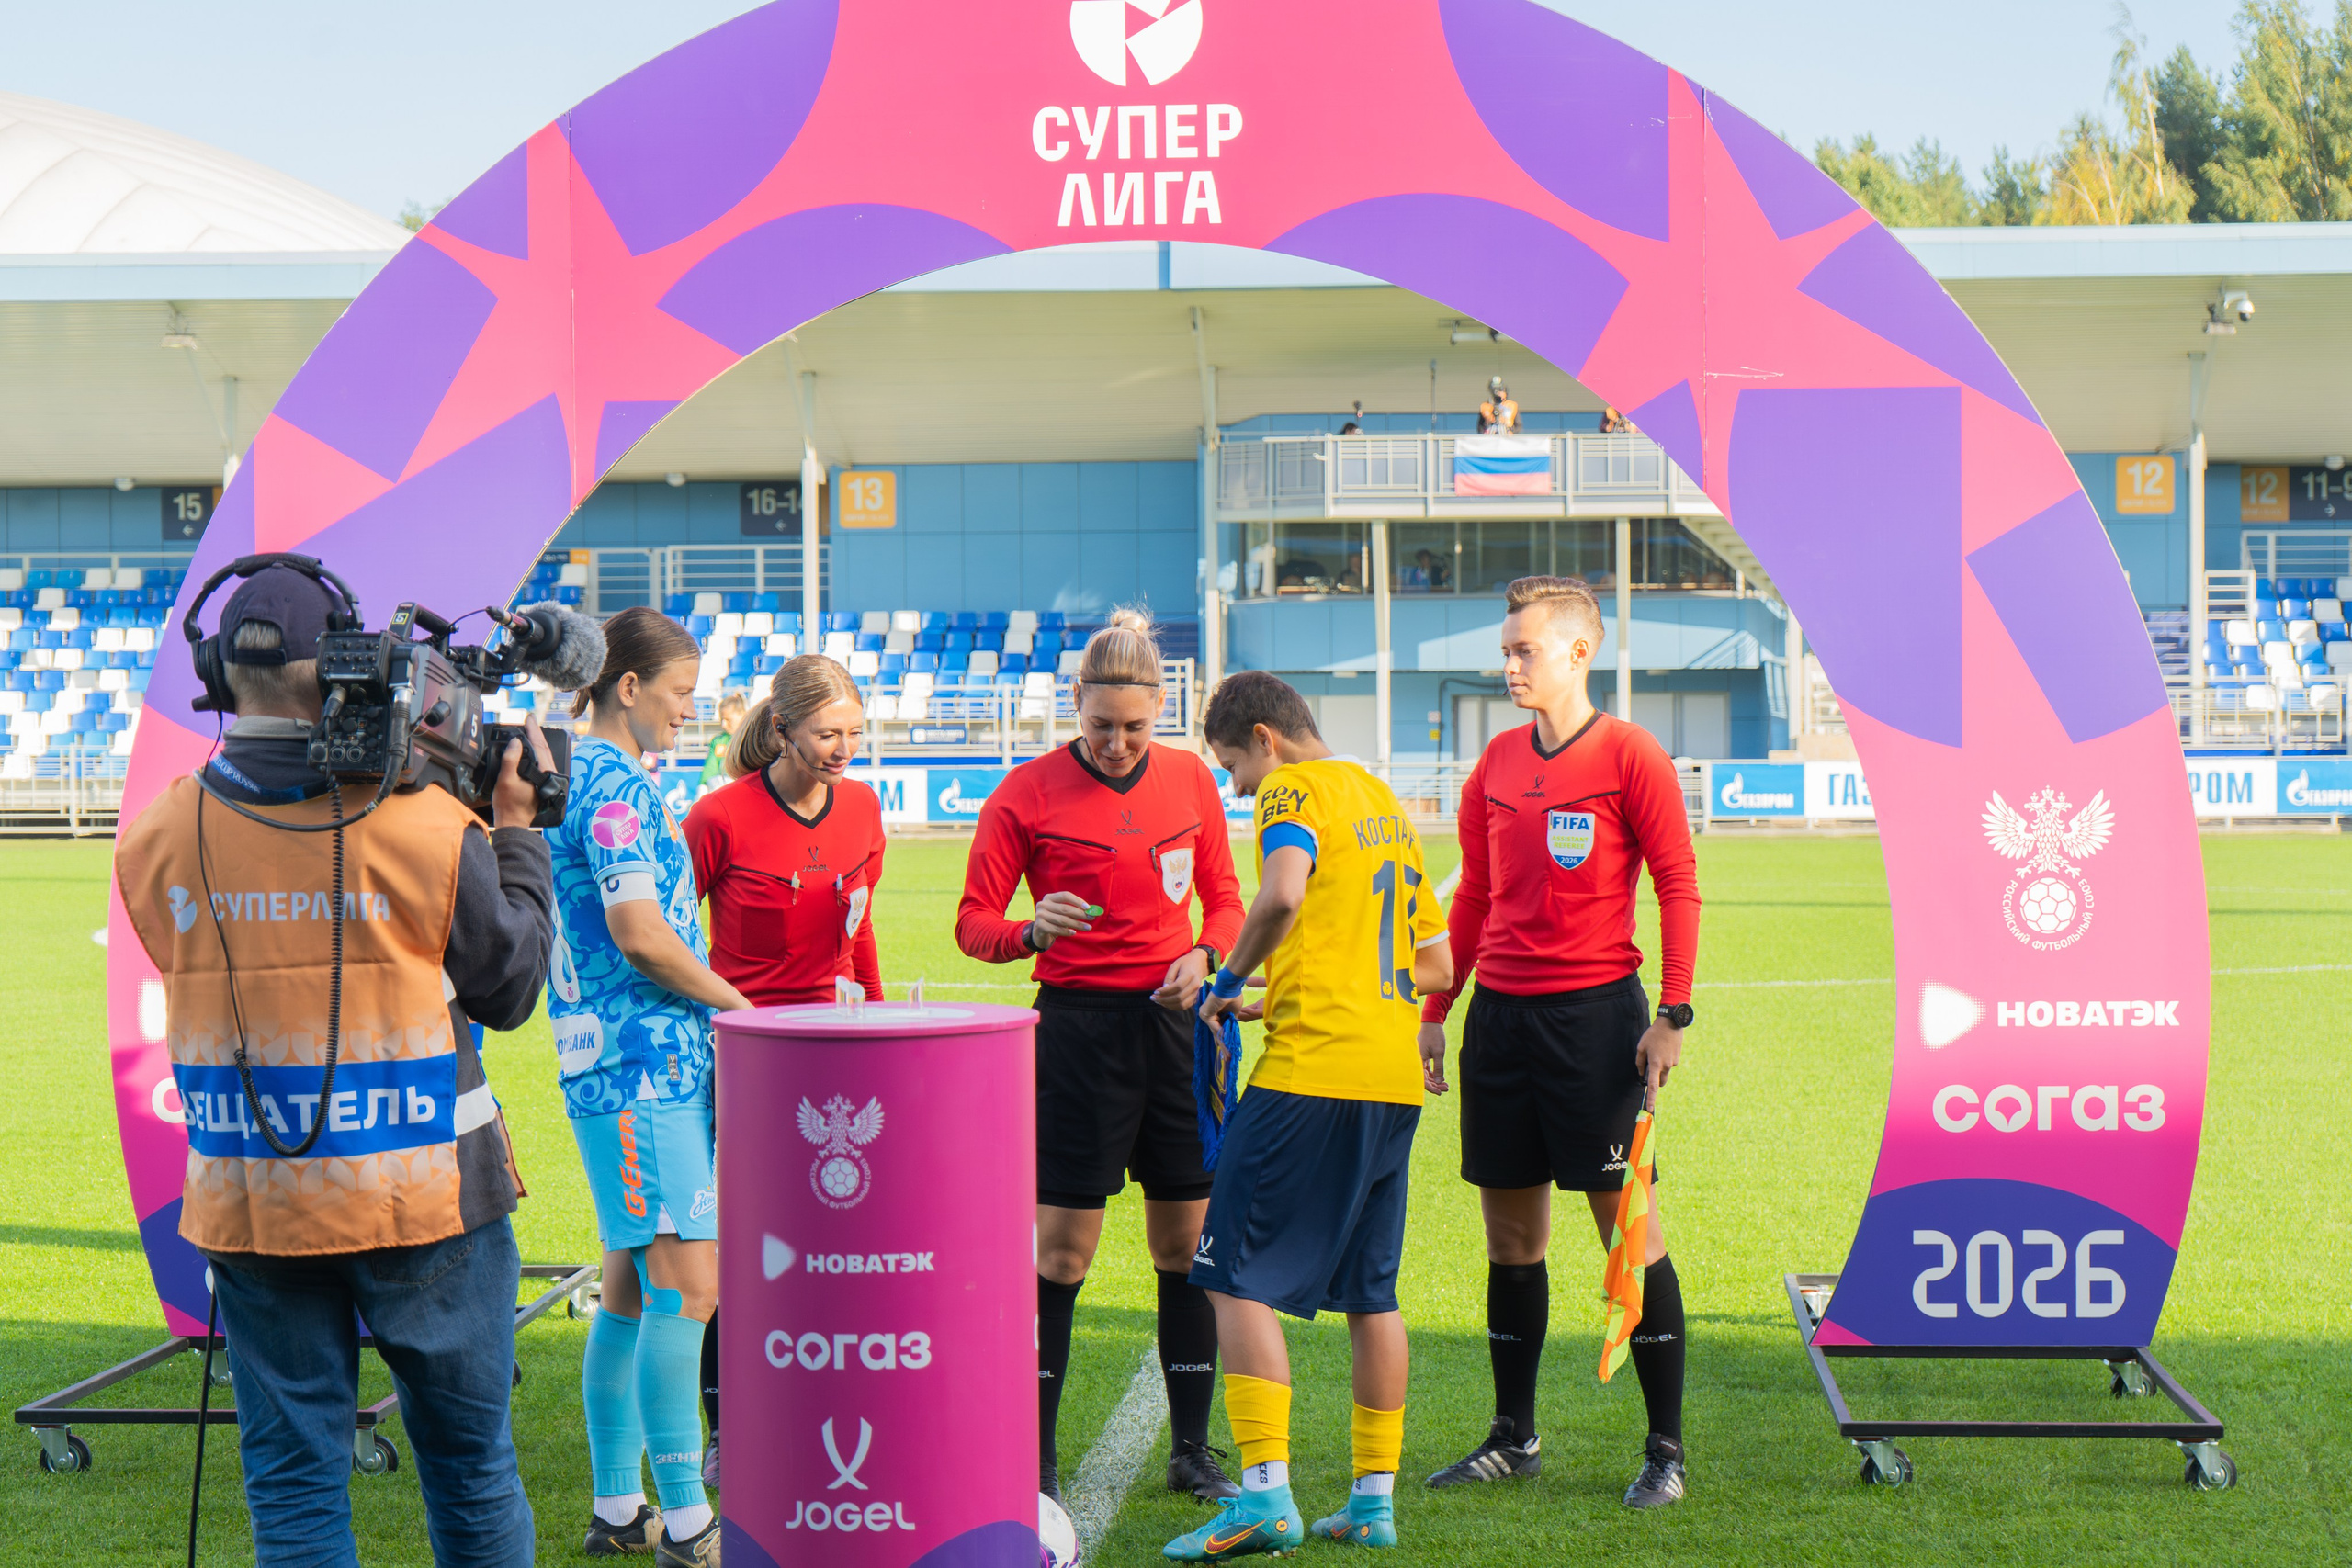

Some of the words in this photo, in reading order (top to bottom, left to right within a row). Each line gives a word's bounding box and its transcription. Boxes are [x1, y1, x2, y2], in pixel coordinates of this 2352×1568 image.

[1033, 104, 1243, 162] СУПЕР
[1057, 171, 1222, 227] ЛИГА
[2127, 461, 2164, 496] 12
[2243, 471, 2278, 504] 12
[173, 492, 203, 521] 15
[747, 487, 802, 516] 16-1
[847, 477, 884, 511] 13
[395, 614, 405, 623] 5
[470, 713, 479, 738] 5
[616, 822, 632, 836] СУПЕР
[621, 828, 634, 840] ЛИГА
[1553, 816, 1589, 830] FIFA
[1552, 835, 1589, 843] ASSISTANT
[1561, 856, 1578, 864] 2026
[210, 890, 390, 921] СУПЕРЛИГА
[2002, 879, 2031, 944] РОССИЙСКИЙ
[2031, 911, 2094, 952] ФУТБОЛЬНЫЙ
[2077, 878, 2095, 908] СОЮЗ
[1997, 1000, 2180, 1027] НОВАТЭК
[555, 1031, 596, 1056] ОМБАНК
[806, 1252, 935, 1273] НОВАТЭК
[1912, 1229, 2127, 1318] 2026
[655, 1451, 701, 1465] ЗЕНИ
[1259, 1462, 1269, 1484] CKS
